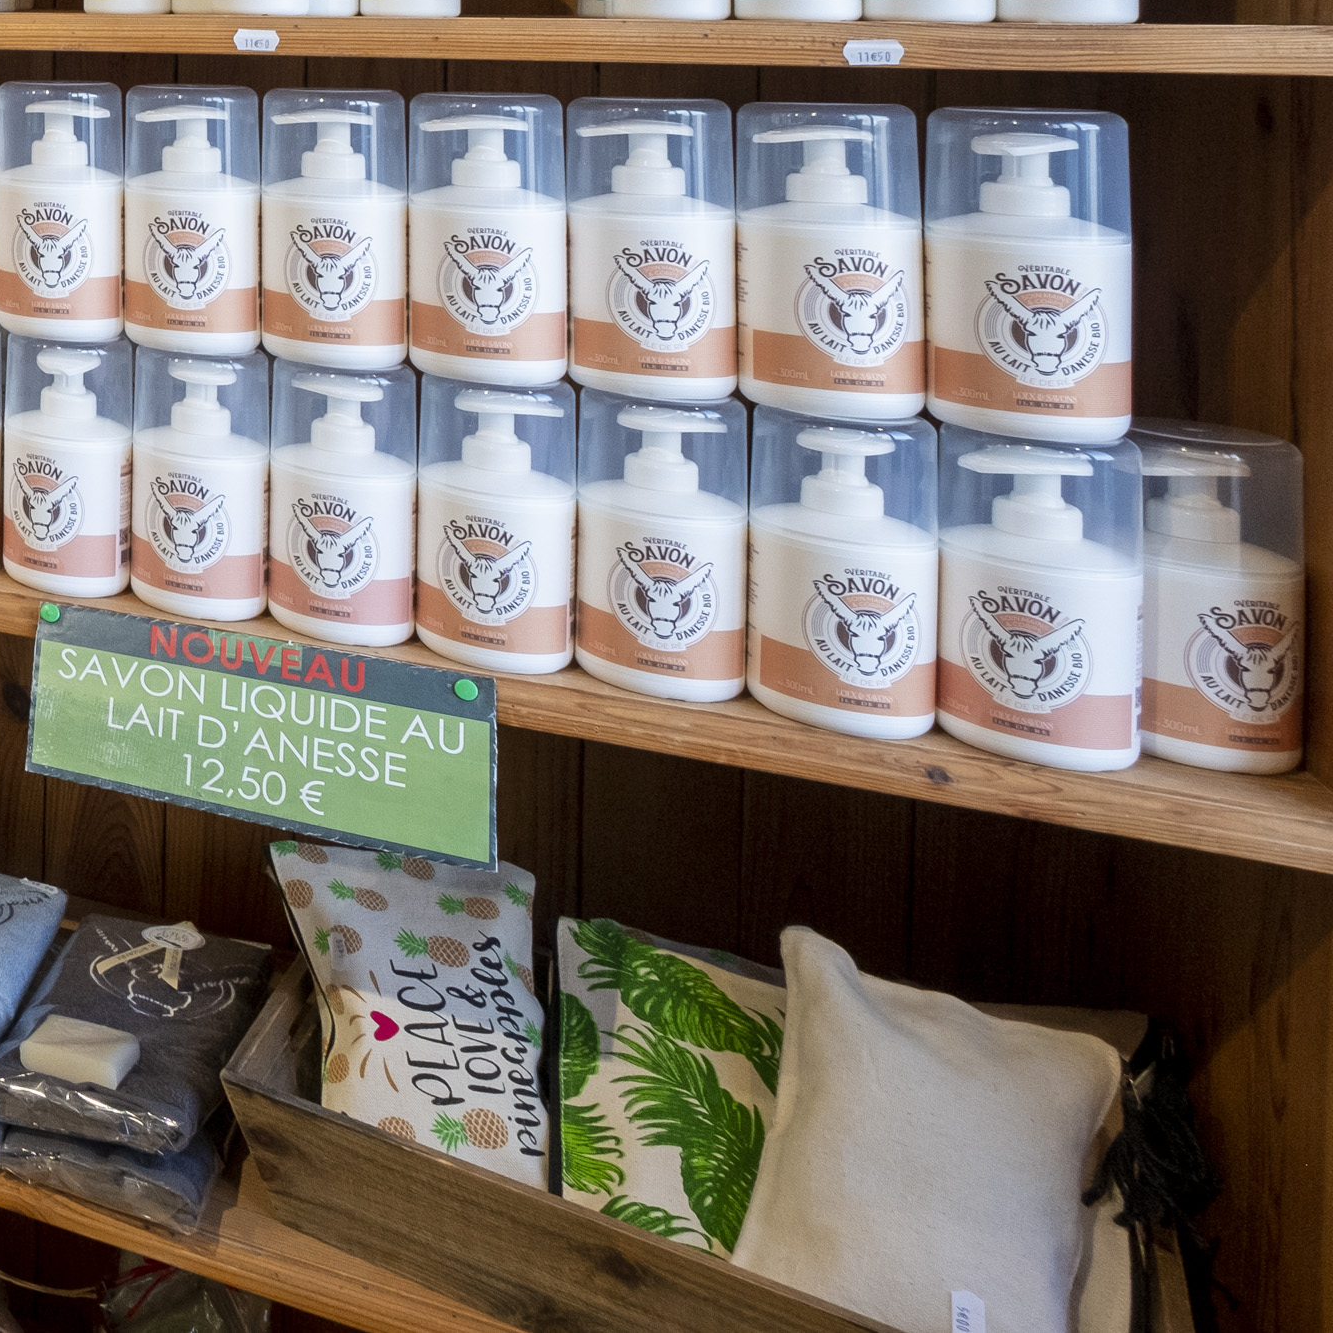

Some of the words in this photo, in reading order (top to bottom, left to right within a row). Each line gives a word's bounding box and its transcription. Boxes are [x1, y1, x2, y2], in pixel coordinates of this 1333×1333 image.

[298, 224, 357, 244] SAVON
[813, 256, 889, 278] SAVON
[995, 272, 1081, 296] SAVON
[988, 341, 1005, 355] AU
[1002, 354, 1031, 373] LAIT
[1090, 322, 1101, 338] BIO
[624, 541, 695, 568] SAVON
[1208, 606, 1287, 631] SAVON
[149, 624, 366, 693] NOUVEAU
[58, 647, 206, 705] SAVON
[220, 677, 388, 741] LIQUIDE
[400, 714, 466, 755] AU
[107, 697, 185, 742] LAIT
[182, 753, 288, 807] 12,50
[299, 779, 327, 816] €
[446, 983, 487, 1008] &
[390, 959, 466, 1106] PEACE
[452, 1014, 506, 1094] LOVE
[472, 930, 546, 1157] pineapples
